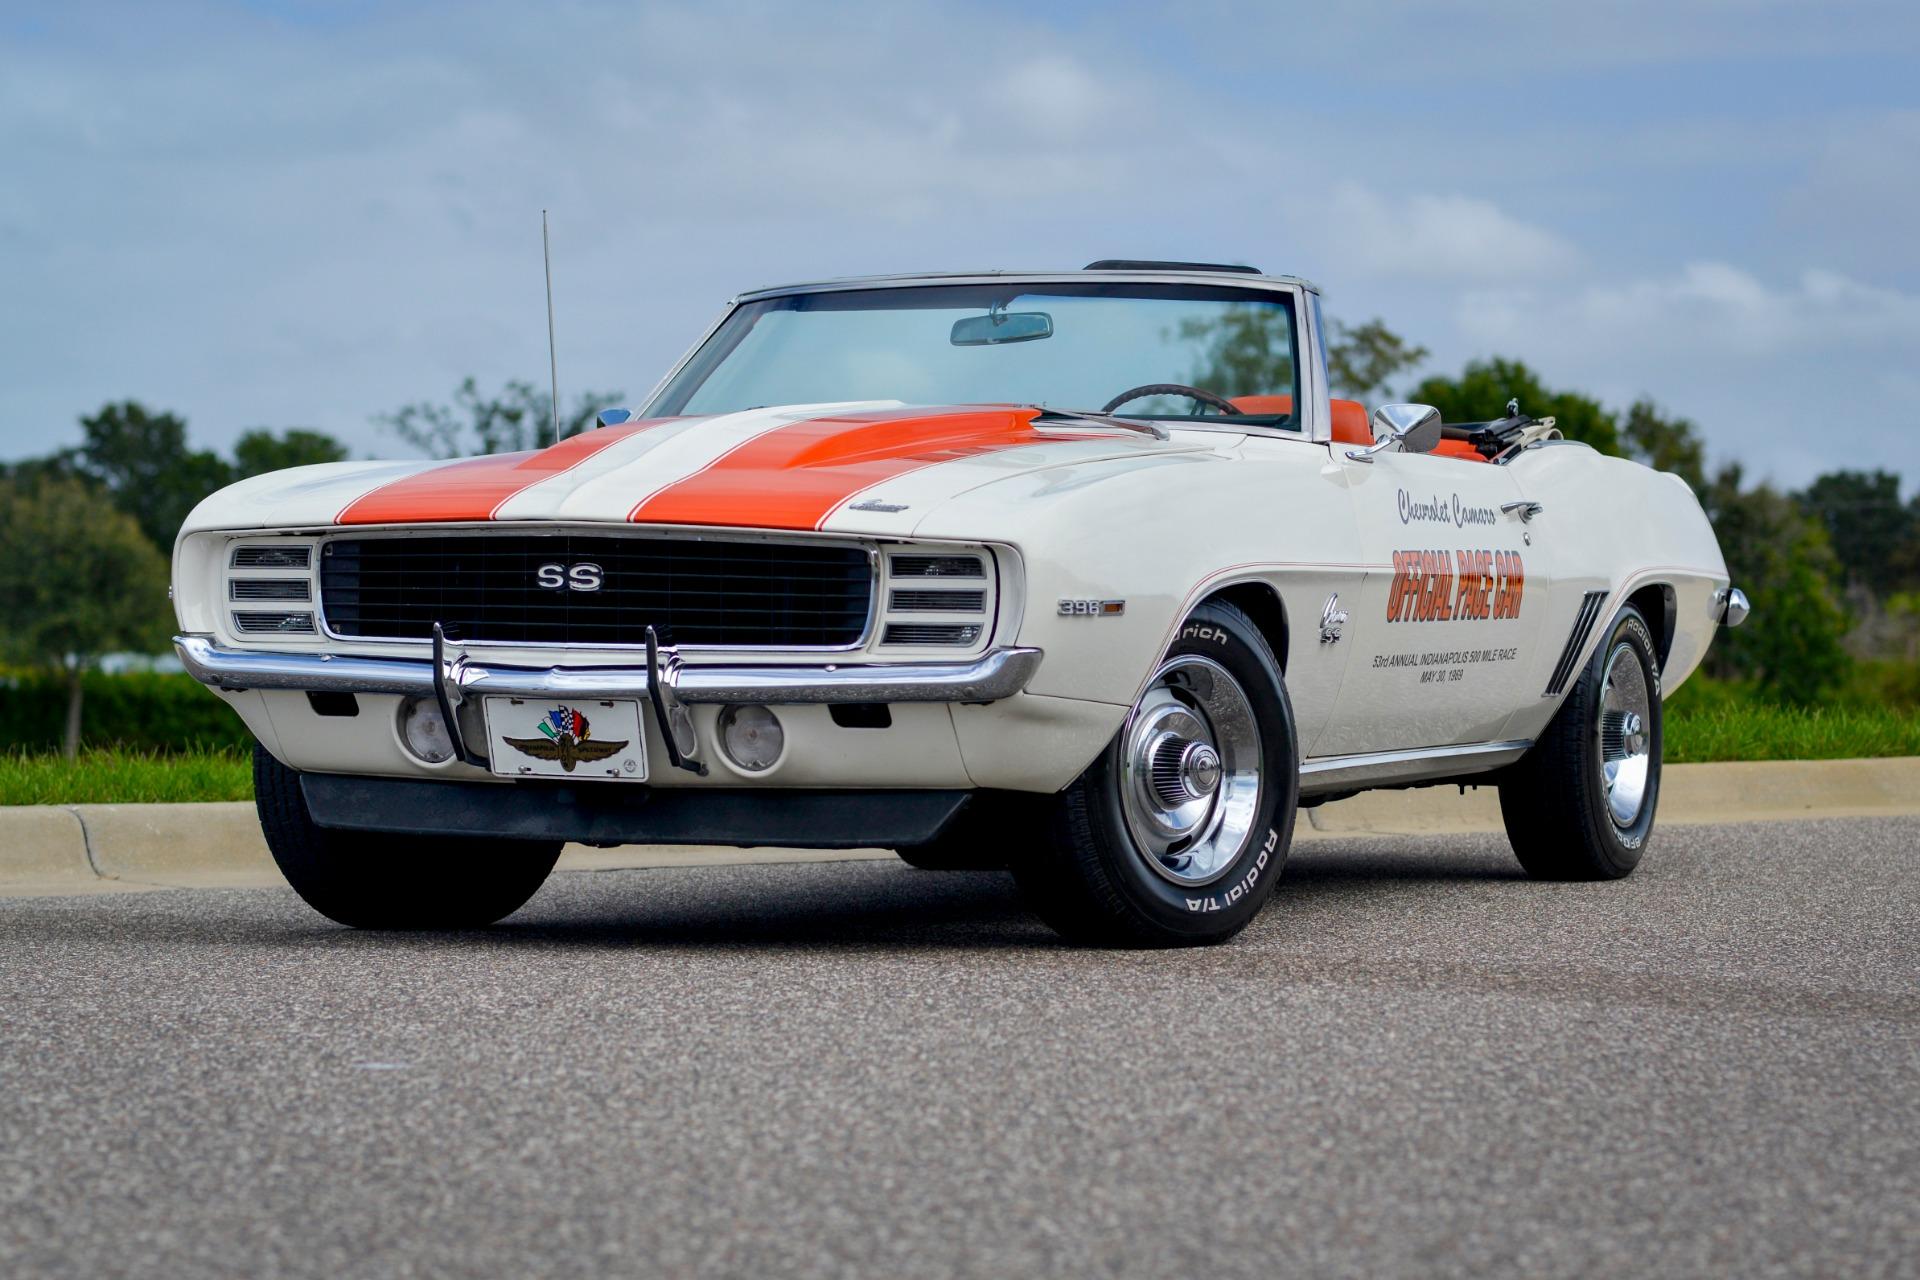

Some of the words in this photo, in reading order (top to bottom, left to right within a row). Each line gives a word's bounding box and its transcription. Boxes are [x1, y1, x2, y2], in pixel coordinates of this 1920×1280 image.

[1397, 488, 1450, 525] Chevrolet
[1452, 493, 1496, 528] Camaro
[537, 562, 604, 592] SS
[1386, 549, 1453, 623] OFFICIAL
[1452, 549, 1494, 621] PACE
[1493, 549, 1524, 620] CAR
[1057, 600, 1100, 616] 396
[1627, 619, 1653, 655] Radial
[1372, 655, 1390, 668] 53rd
[1388, 653, 1418, 667] ANNUAL
[1419, 650, 1469, 666] INDIANAPOLIS
[1468, 649, 1481, 663] 500
[1480, 648, 1499, 662] MILE
[1498, 647, 1518, 661] RACE
[1419, 670, 1438, 683] MAY
[1447, 668, 1464, 682] 1969
[1224, 828, 1278, 906] Radial
[1185, 897, 1221, 913] T/A
